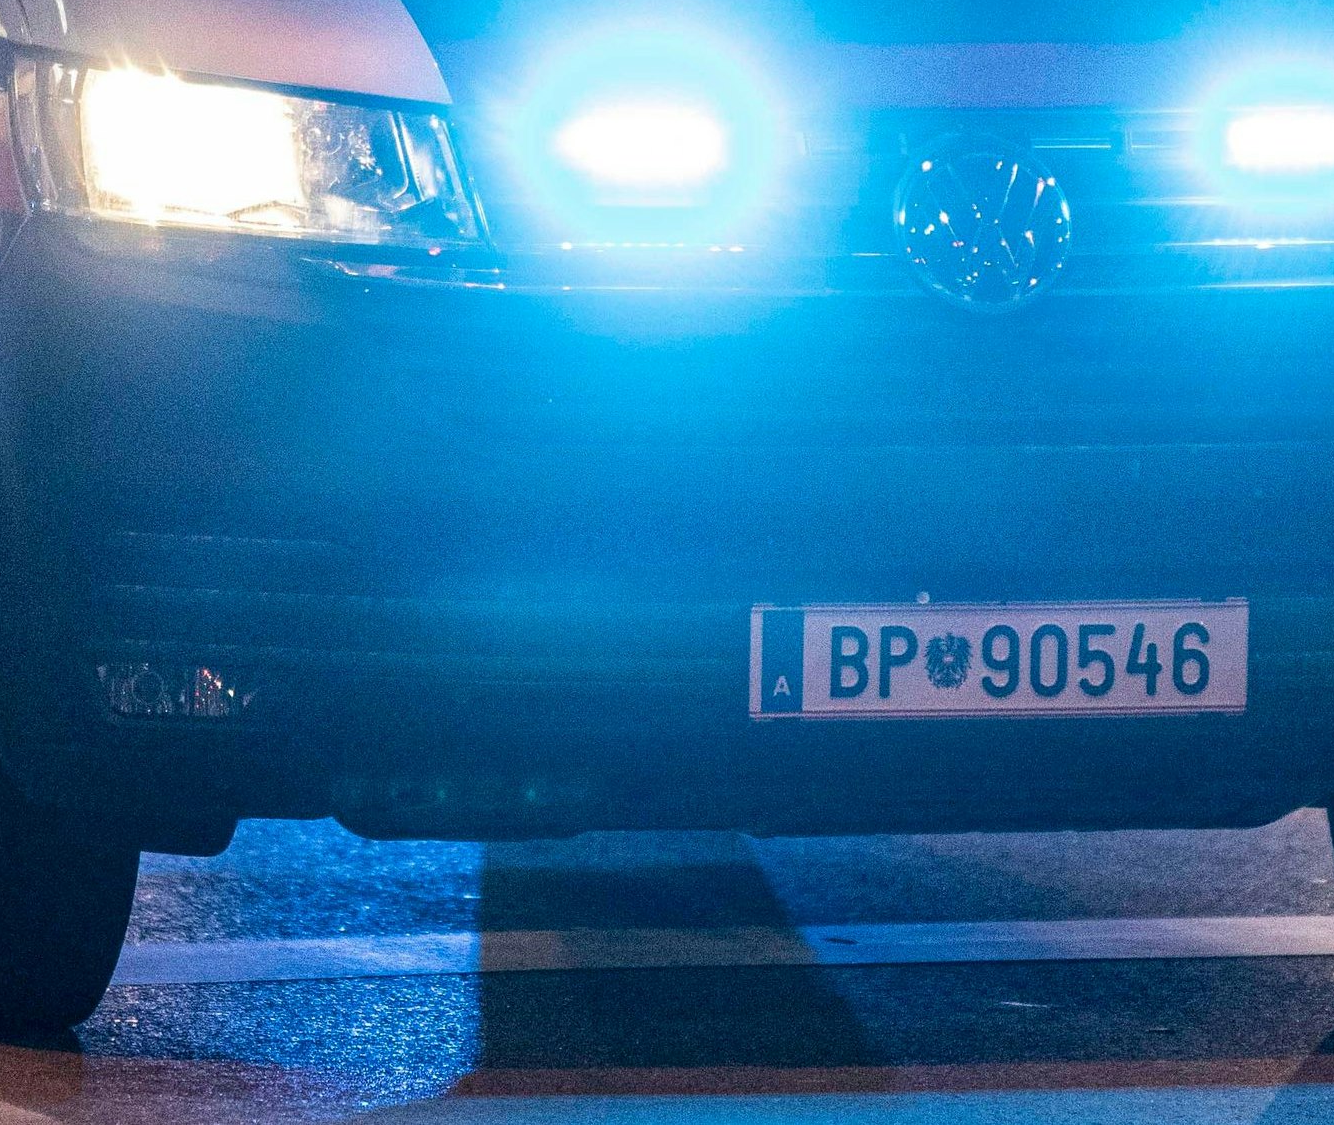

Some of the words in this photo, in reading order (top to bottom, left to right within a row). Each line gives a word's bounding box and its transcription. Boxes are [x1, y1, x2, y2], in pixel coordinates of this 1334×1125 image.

[773, 675, 792, 697] A
[829, 624, 918, 699] BP
[981, 621, 1211, 699] 90546
